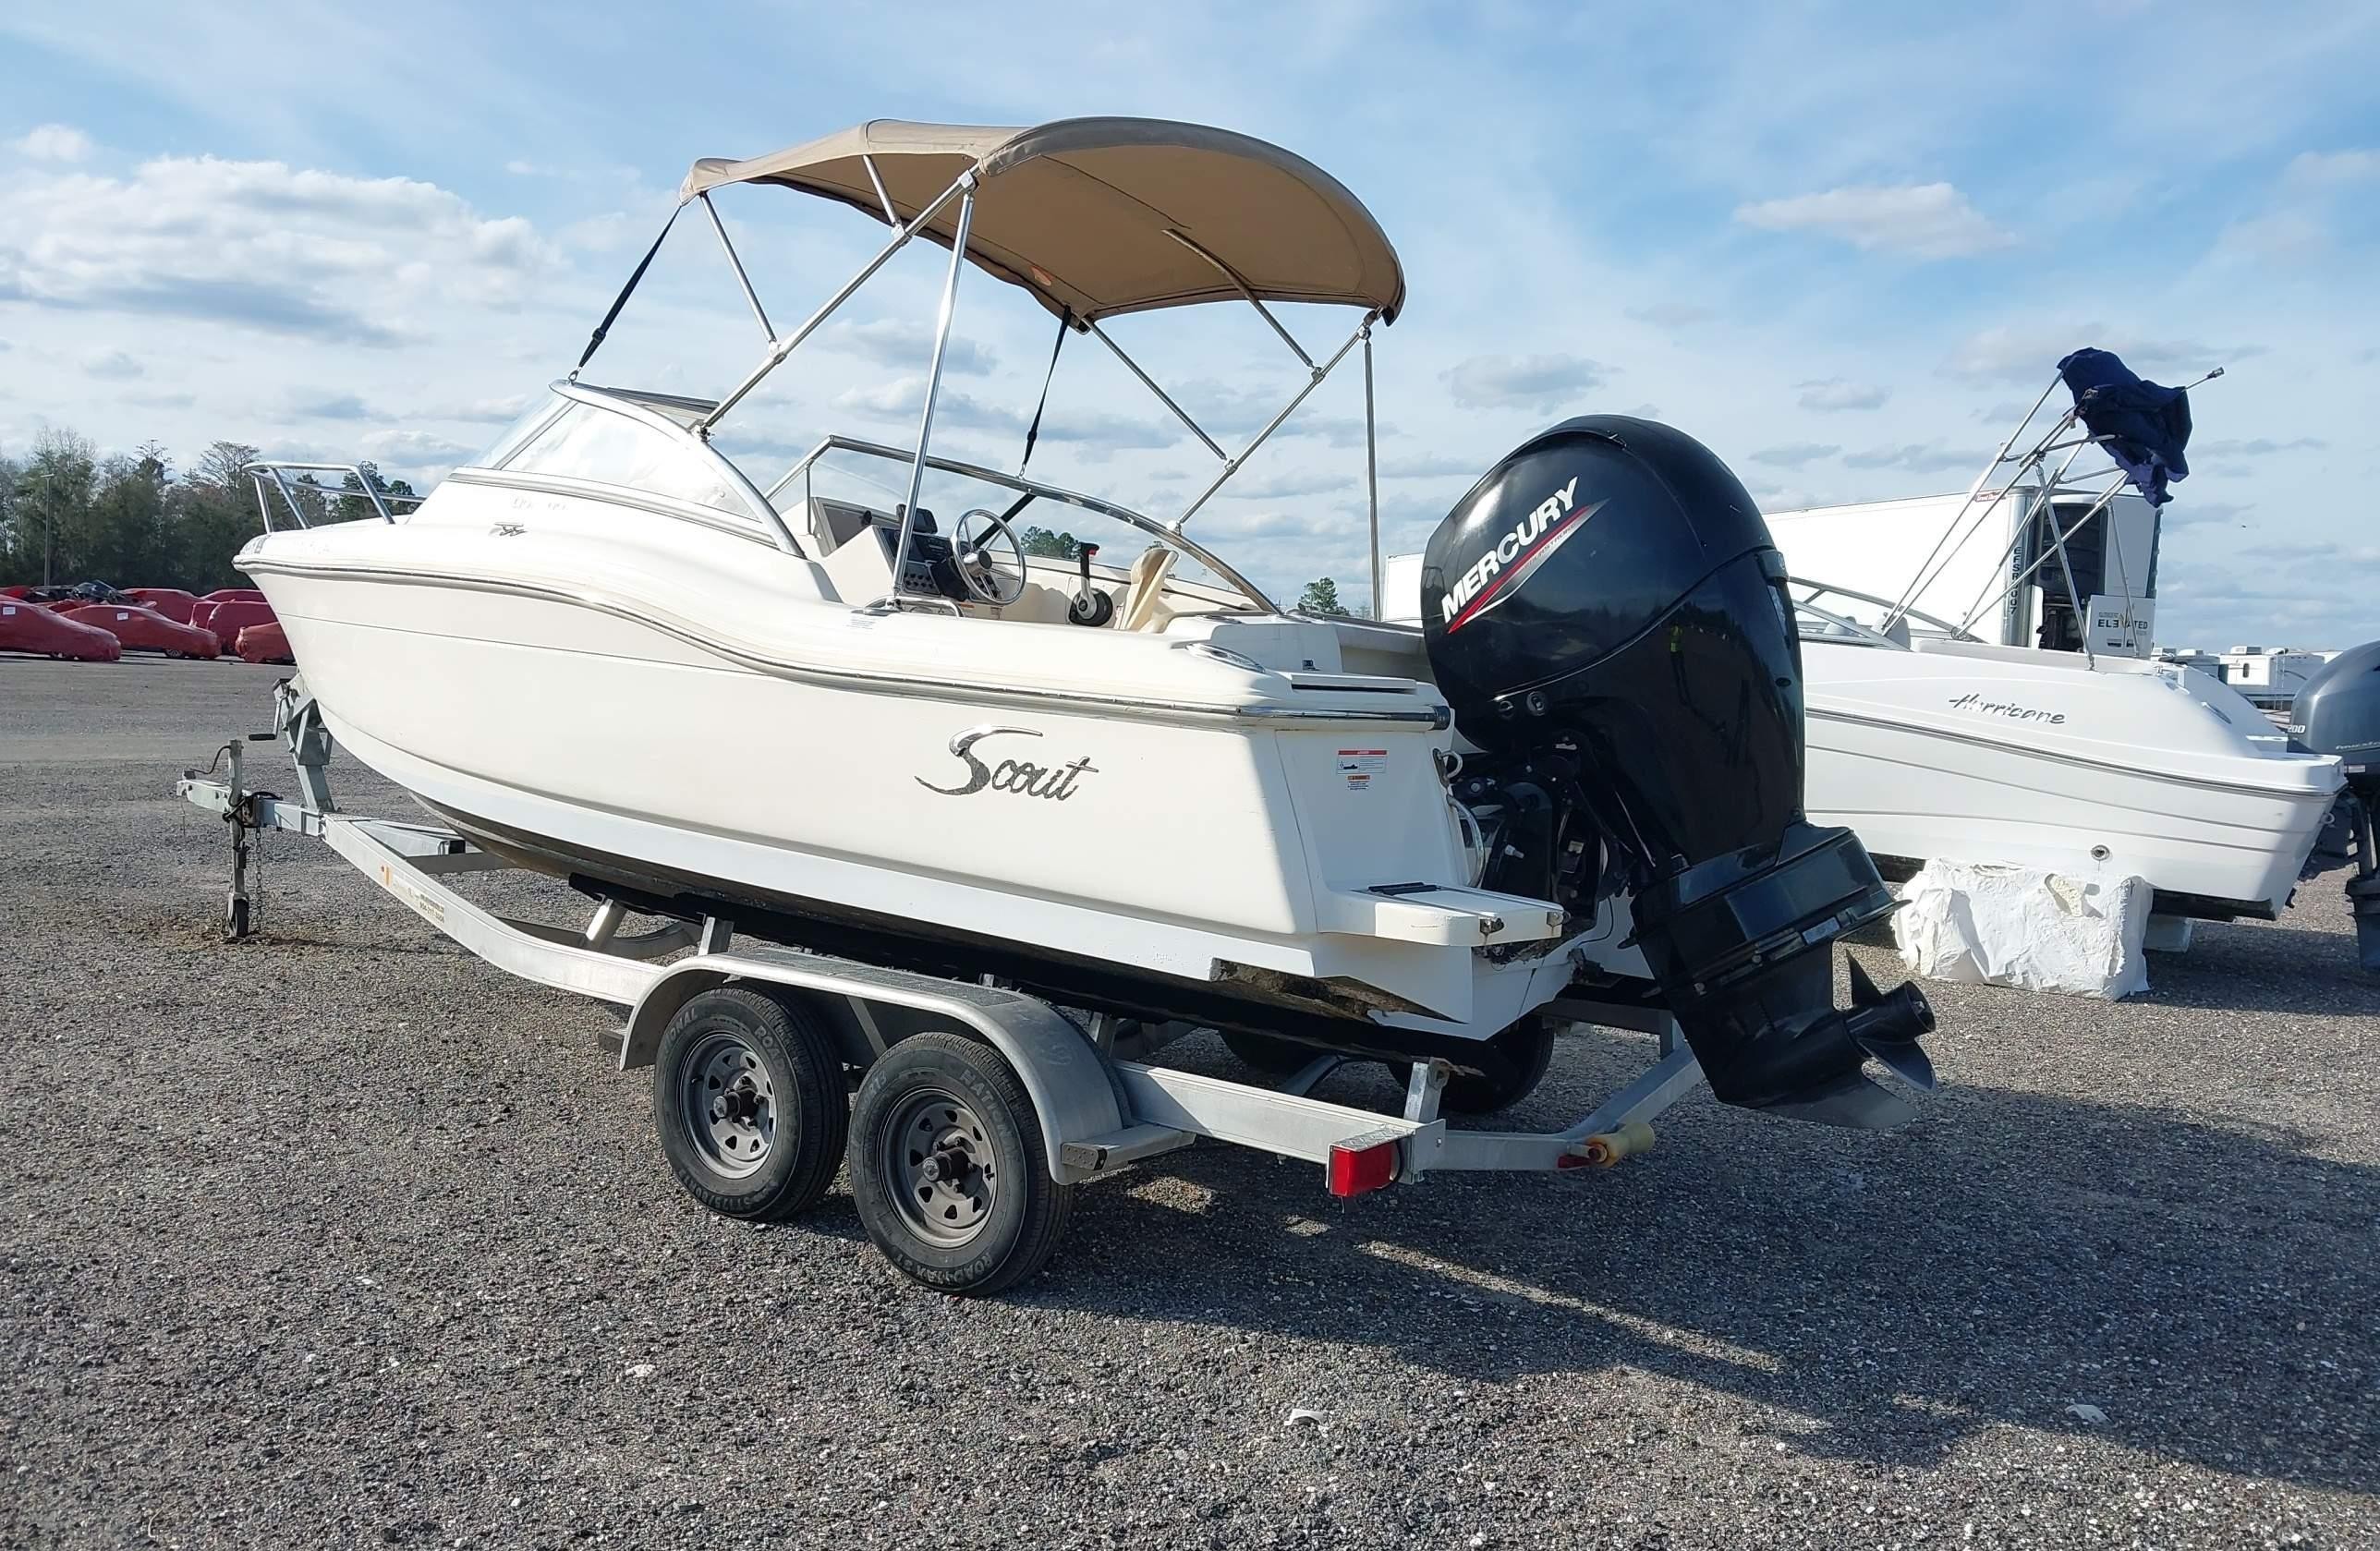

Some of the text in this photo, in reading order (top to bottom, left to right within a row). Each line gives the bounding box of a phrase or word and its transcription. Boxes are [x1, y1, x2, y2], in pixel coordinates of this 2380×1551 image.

[1441, 476, 1578, 624] MERCURY
[1949, 693, 2065, 724] Hurricane
[914, 724, 1099, 801] Scout
